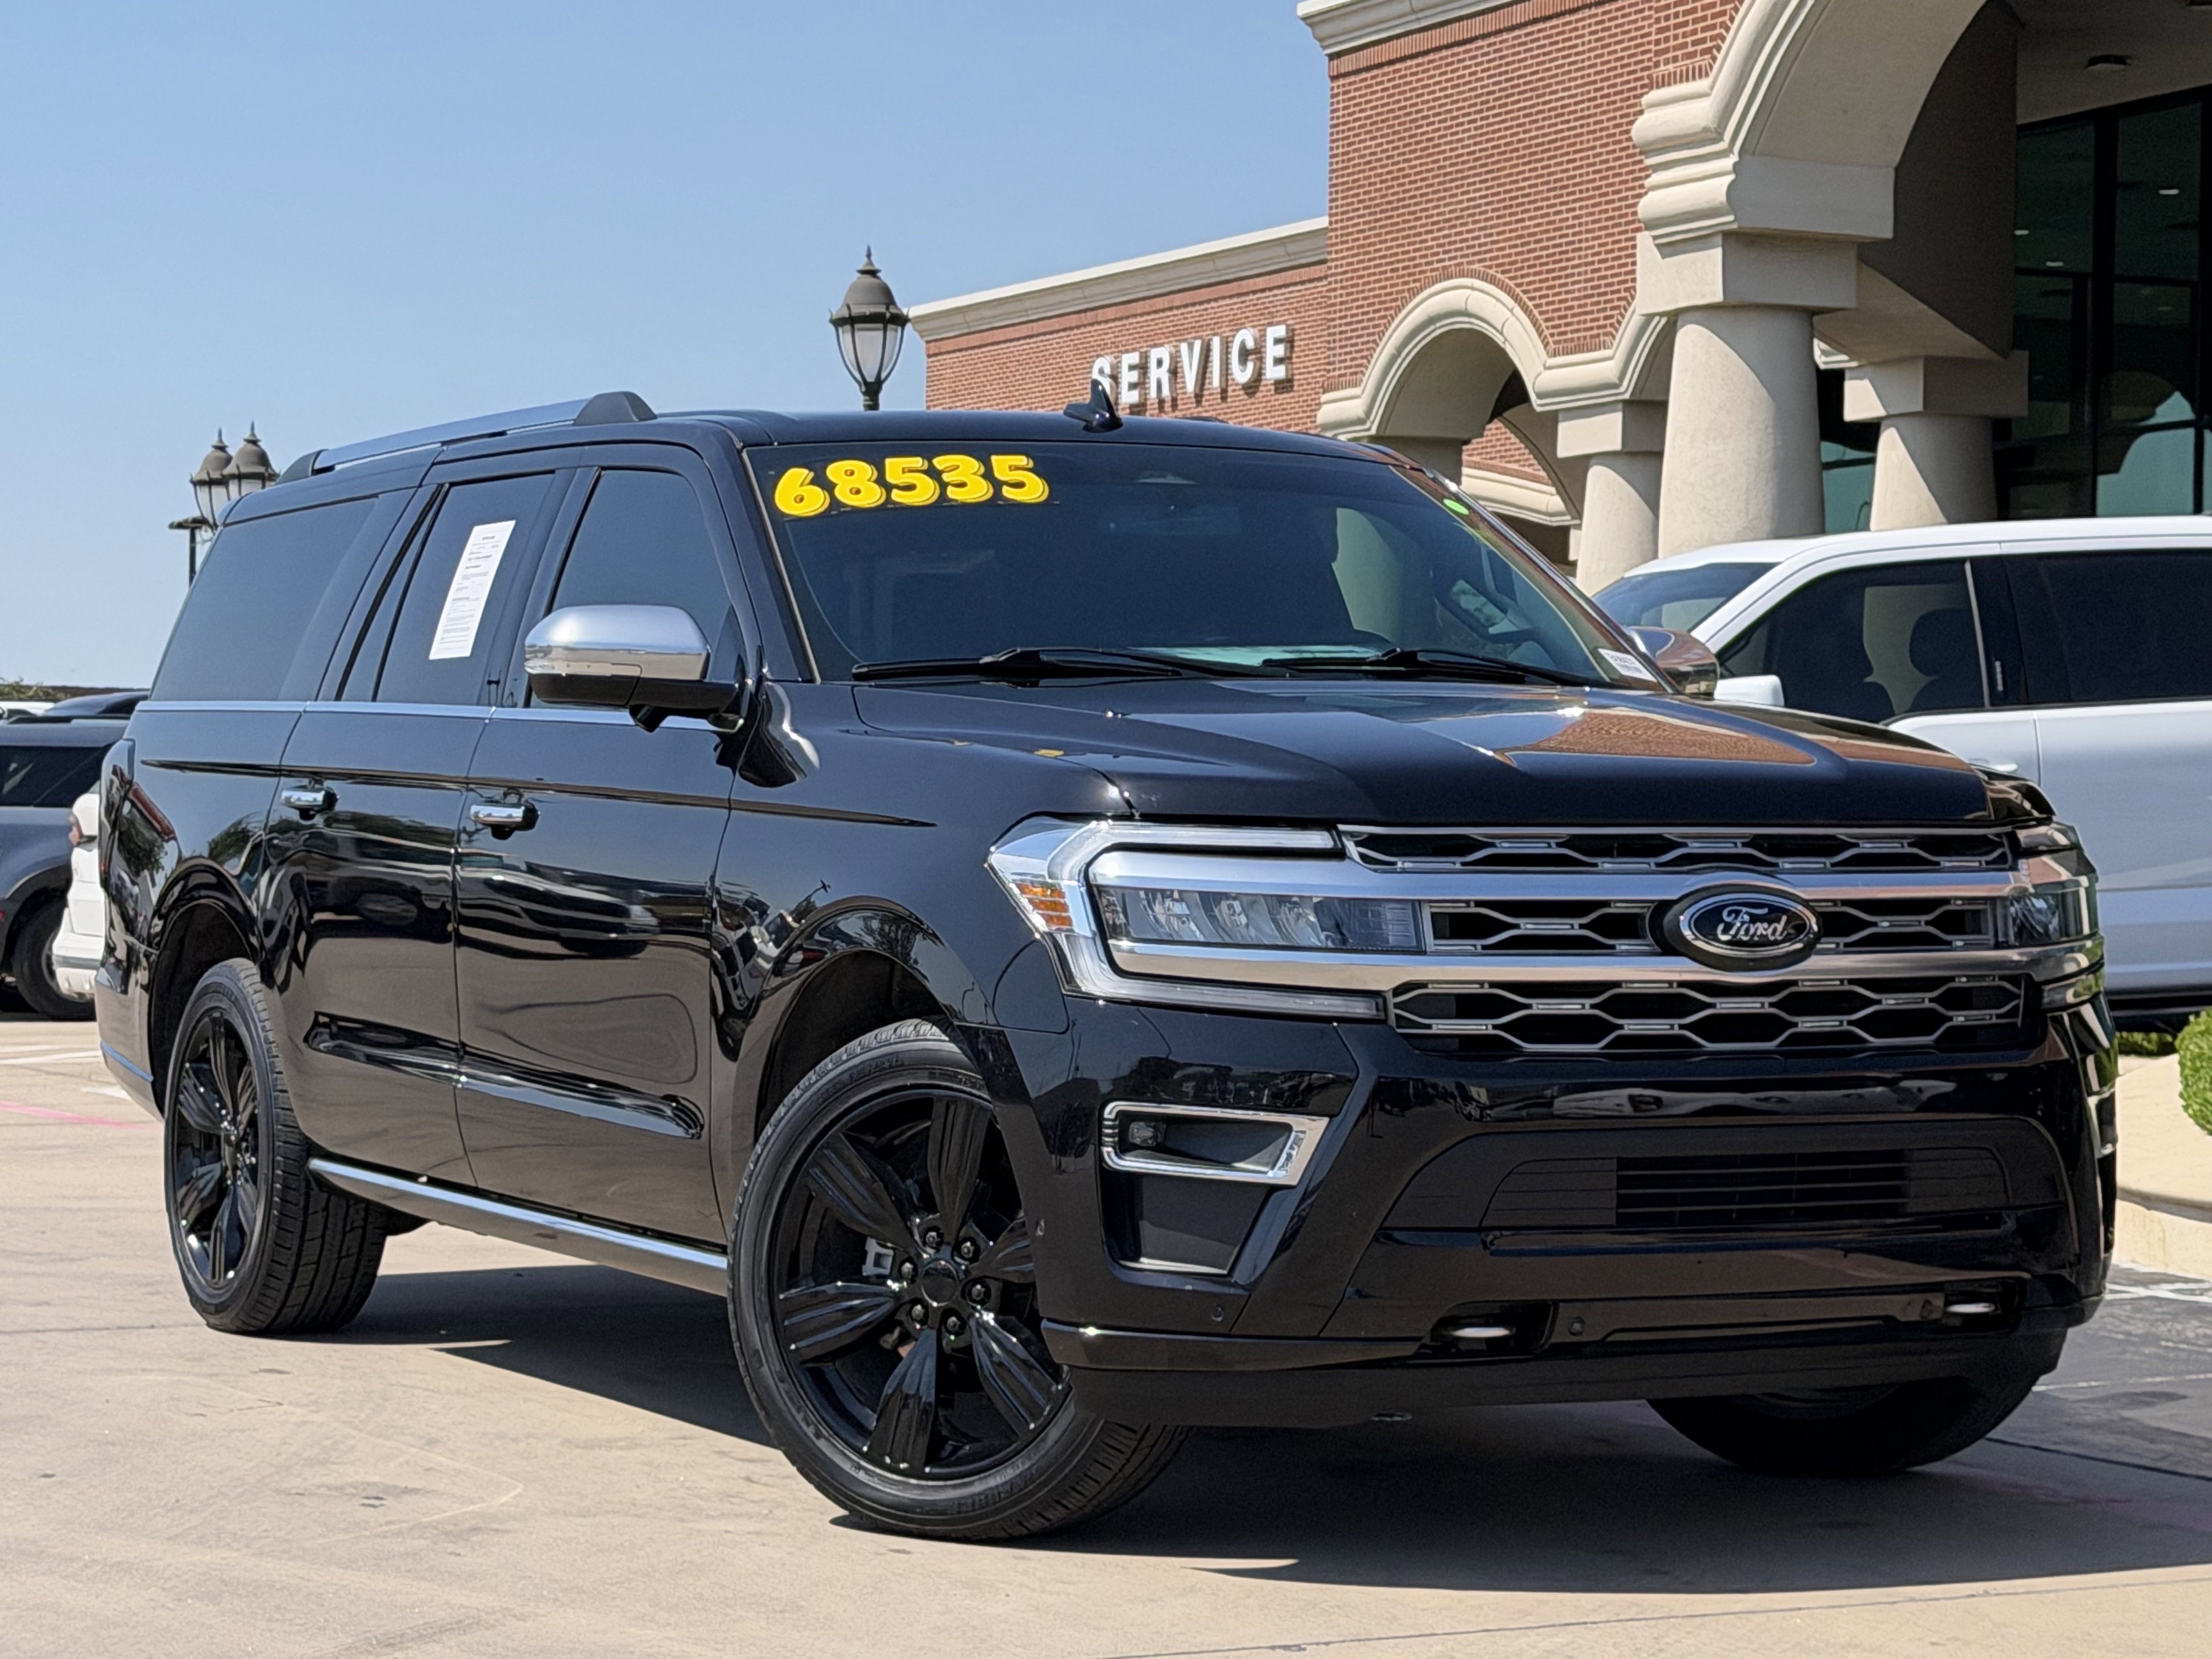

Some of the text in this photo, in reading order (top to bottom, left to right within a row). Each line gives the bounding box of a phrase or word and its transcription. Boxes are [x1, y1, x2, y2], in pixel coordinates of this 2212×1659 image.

[1091, 323, 1289, 404] SERVICE
[774, 454, 1049, 517] 68535
[1717, 906, 1787, 941] Ford
